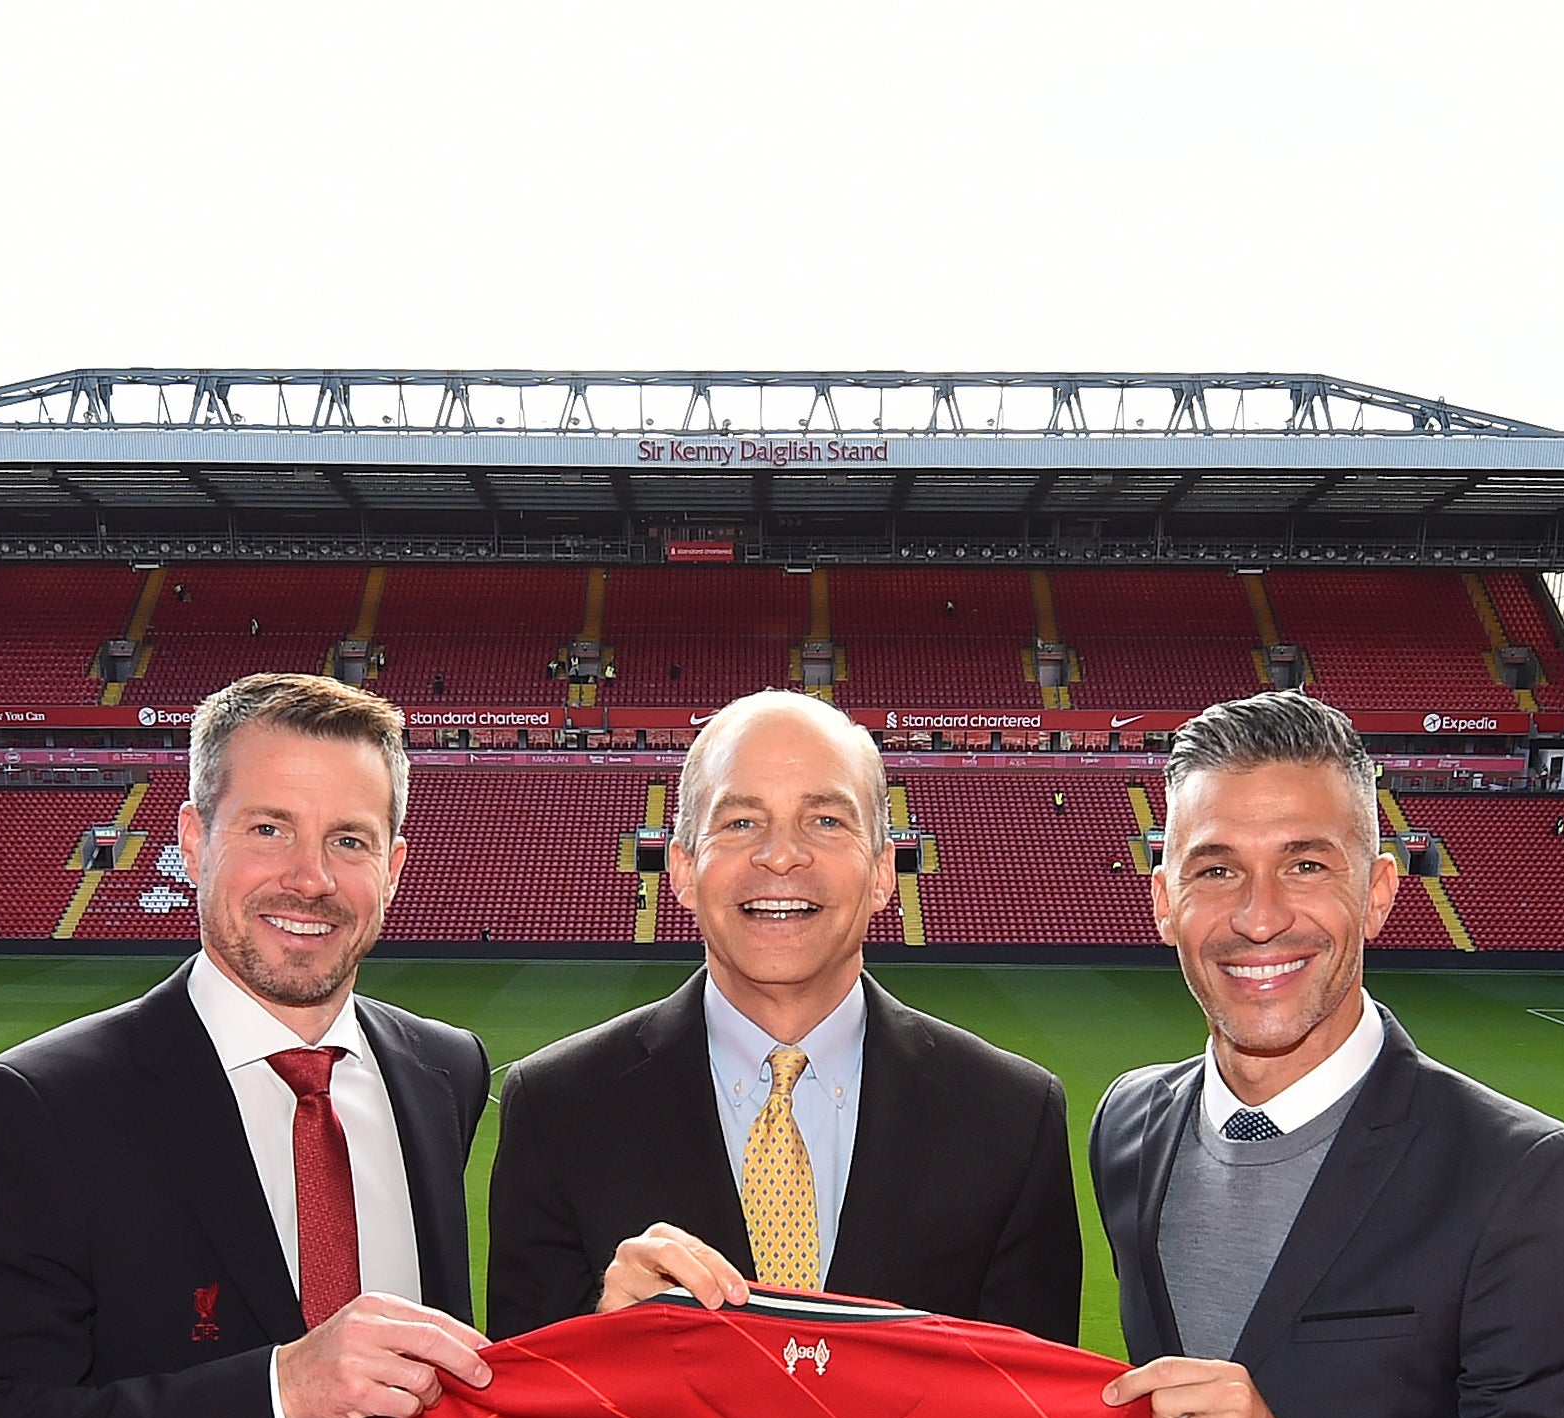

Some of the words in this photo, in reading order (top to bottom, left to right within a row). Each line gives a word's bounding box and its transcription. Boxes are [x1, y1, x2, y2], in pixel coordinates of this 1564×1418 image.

[637, 440, 665, 461] Sir
[670, 440, 735, 466] Kenny
[740, 440, 822, 466] Dalglish
[827, 440, 889, 462] Stand
[5, 711, 24, 721] You
[26, 711, 46, 721] Can
[409, 711, 477, 726] standard
[479, 711, 550, 726] chartered
[901, 713, 968, 728] standard
[970, 713, 1041, 728] chartered
[1441, 716, 1497, 732] Expedia
